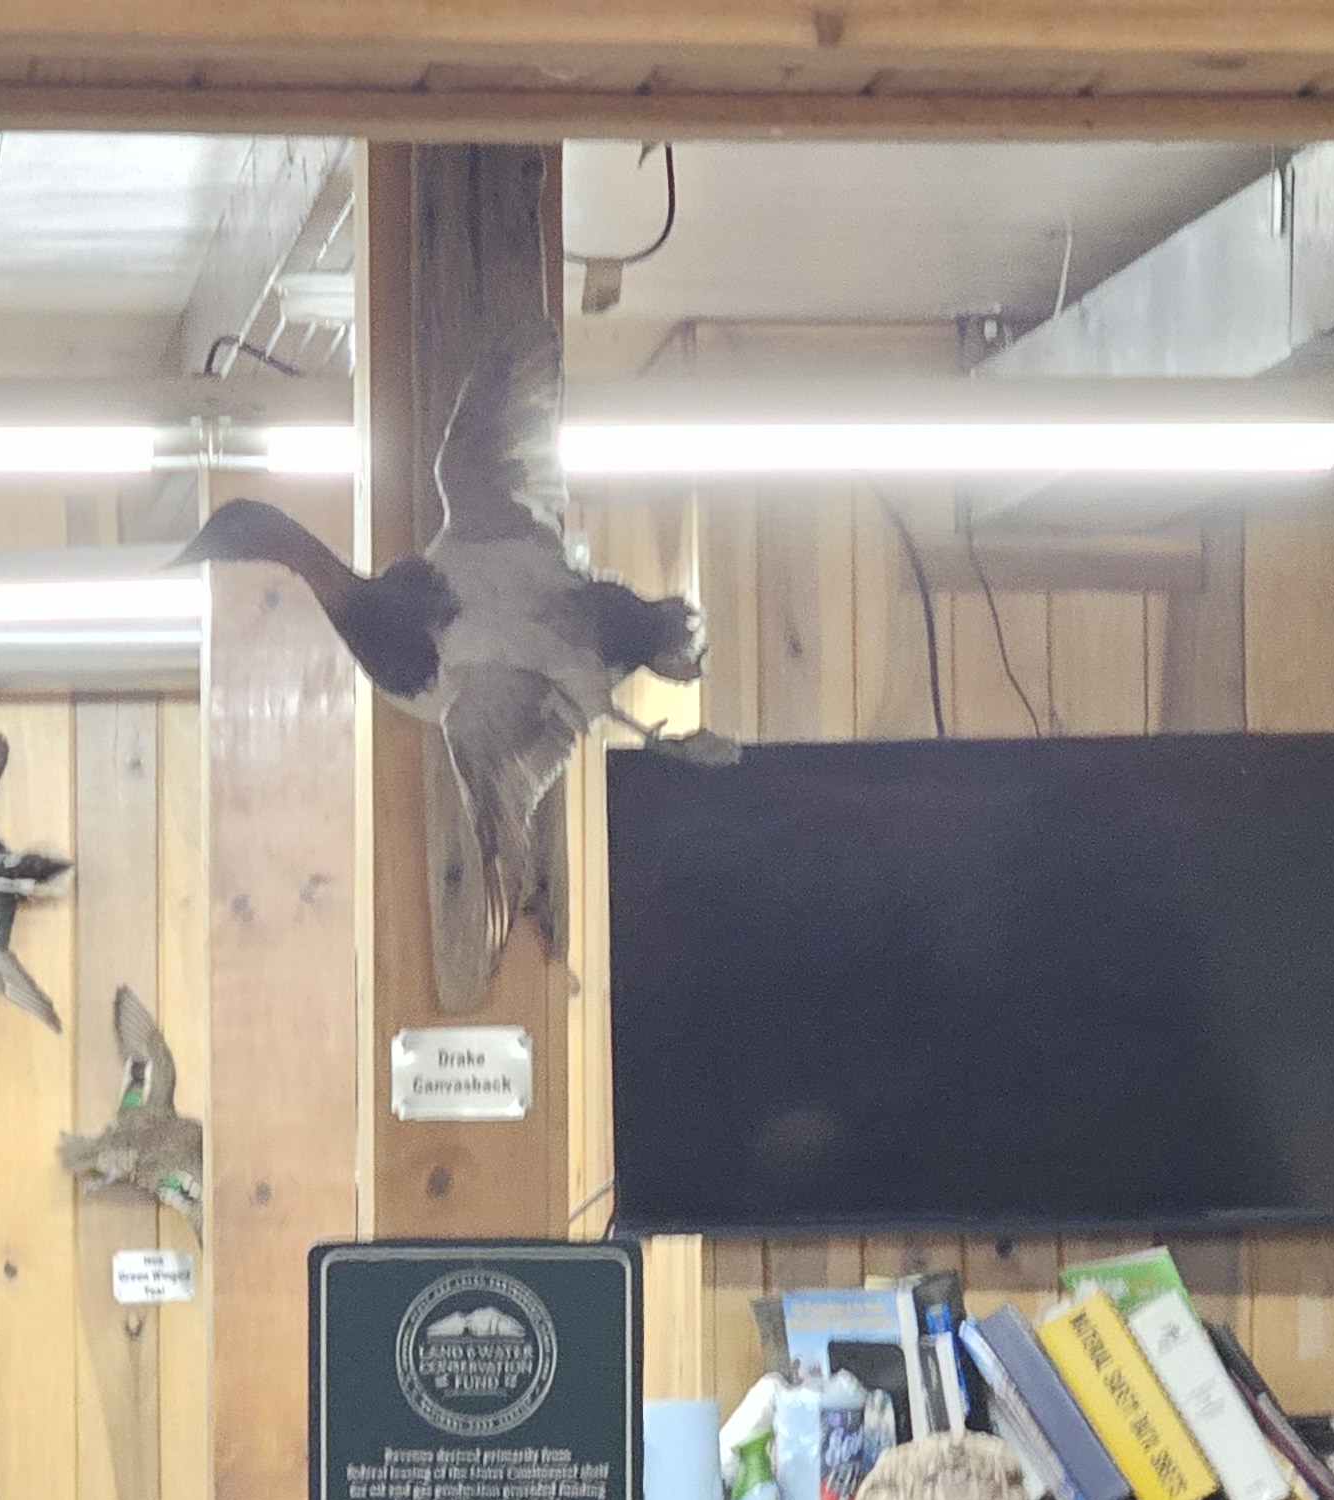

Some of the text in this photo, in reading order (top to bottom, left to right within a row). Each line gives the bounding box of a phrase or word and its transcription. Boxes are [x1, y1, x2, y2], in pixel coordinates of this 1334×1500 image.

[438, 1048, 486, 1068] Drake
[413, 1074, 512, 1094] Canvasback
[1069, 1307, 1113, 1373] MATERIAL
[419, 1344, 464, 1360] LAND
[478, 1344, 533, 1360] WATER
[454, 1374, 500, 1390] FUND
